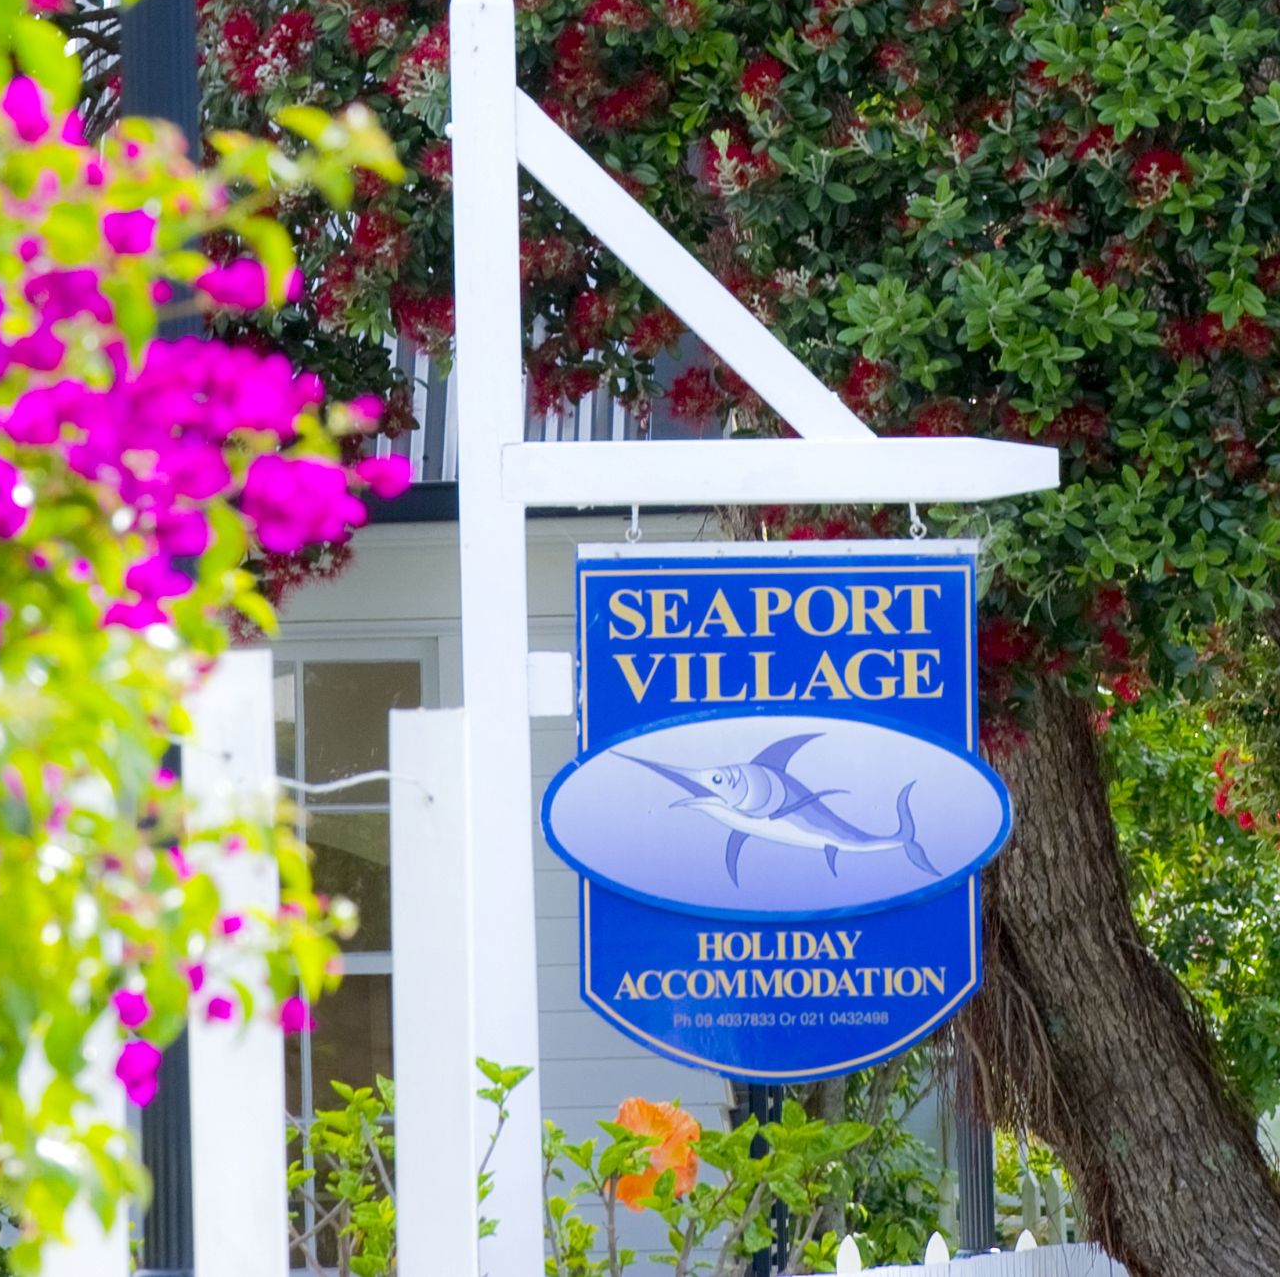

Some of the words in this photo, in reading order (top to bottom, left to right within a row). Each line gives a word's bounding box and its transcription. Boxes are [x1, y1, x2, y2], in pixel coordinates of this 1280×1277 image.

[608, 584, 942, 641] SEAPORT
[612, 648, 944, 704] VILLAGE
[696, 930, 862, 962] HOLIDAY
[613, 966, 946, 1001] ACCOMMODATION
[673, 1013, 692, 1028] Ph
[695, 1013, 713, 1028] 09
[779, 1011, 796, 1026] Or
[800, 1011, 824, 1026] 021
